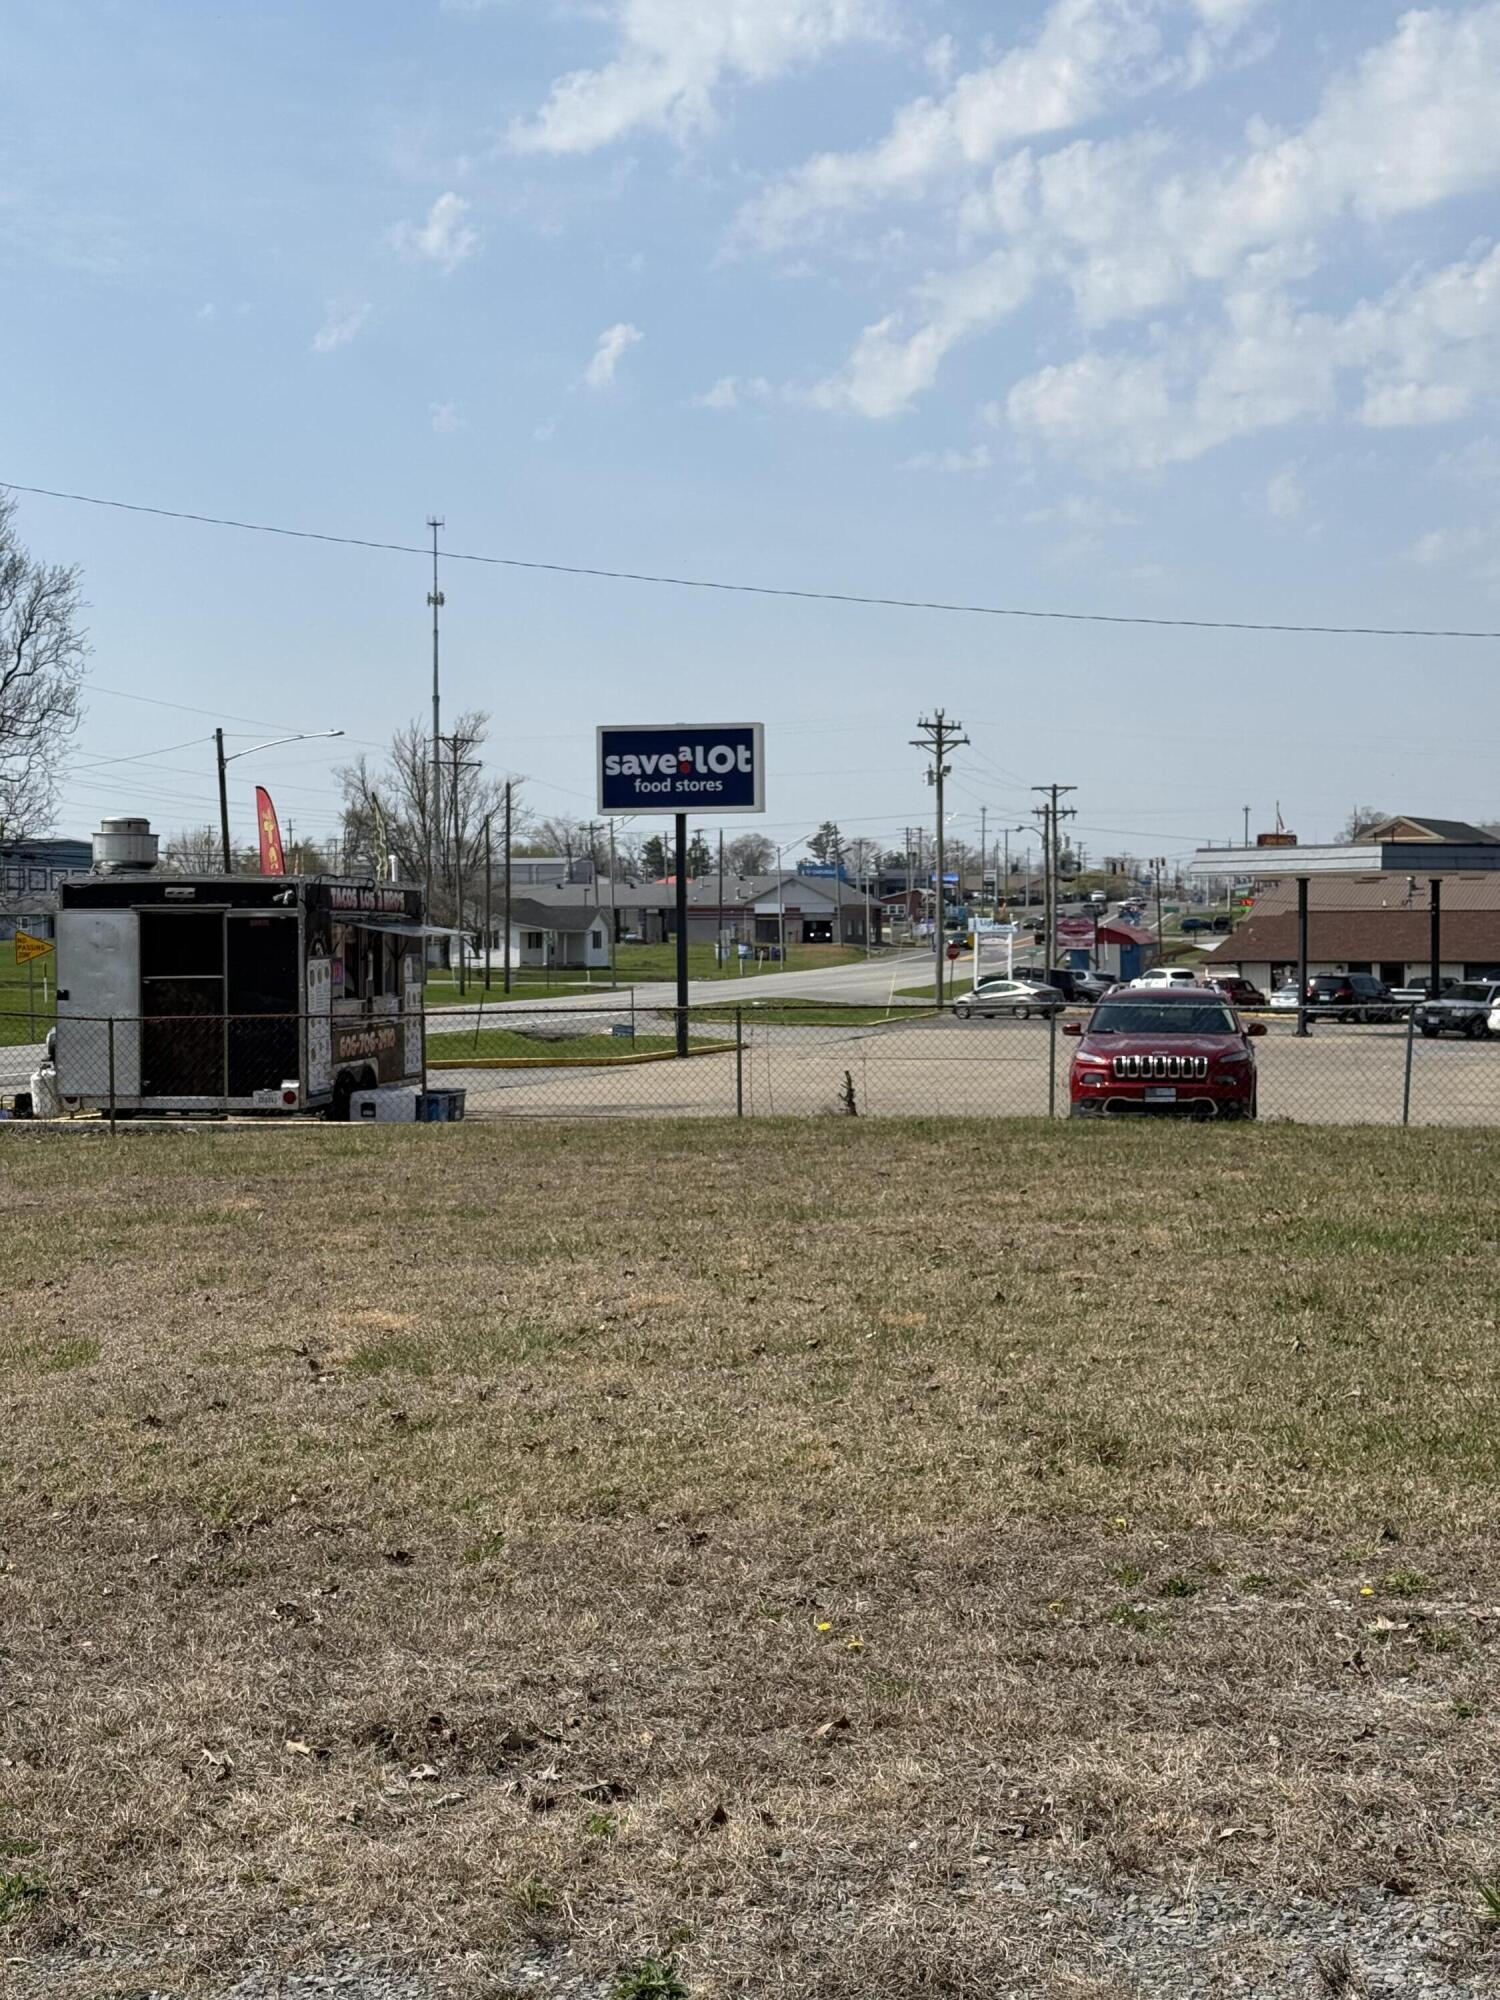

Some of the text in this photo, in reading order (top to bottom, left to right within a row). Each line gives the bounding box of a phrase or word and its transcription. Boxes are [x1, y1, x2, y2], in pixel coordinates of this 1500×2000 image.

[605, 753, 677, 776] save
[634, 777, 724, 793] food stores
[330, 887, 358, 909] TACOS
[360, 889, 376, 911] LOS
